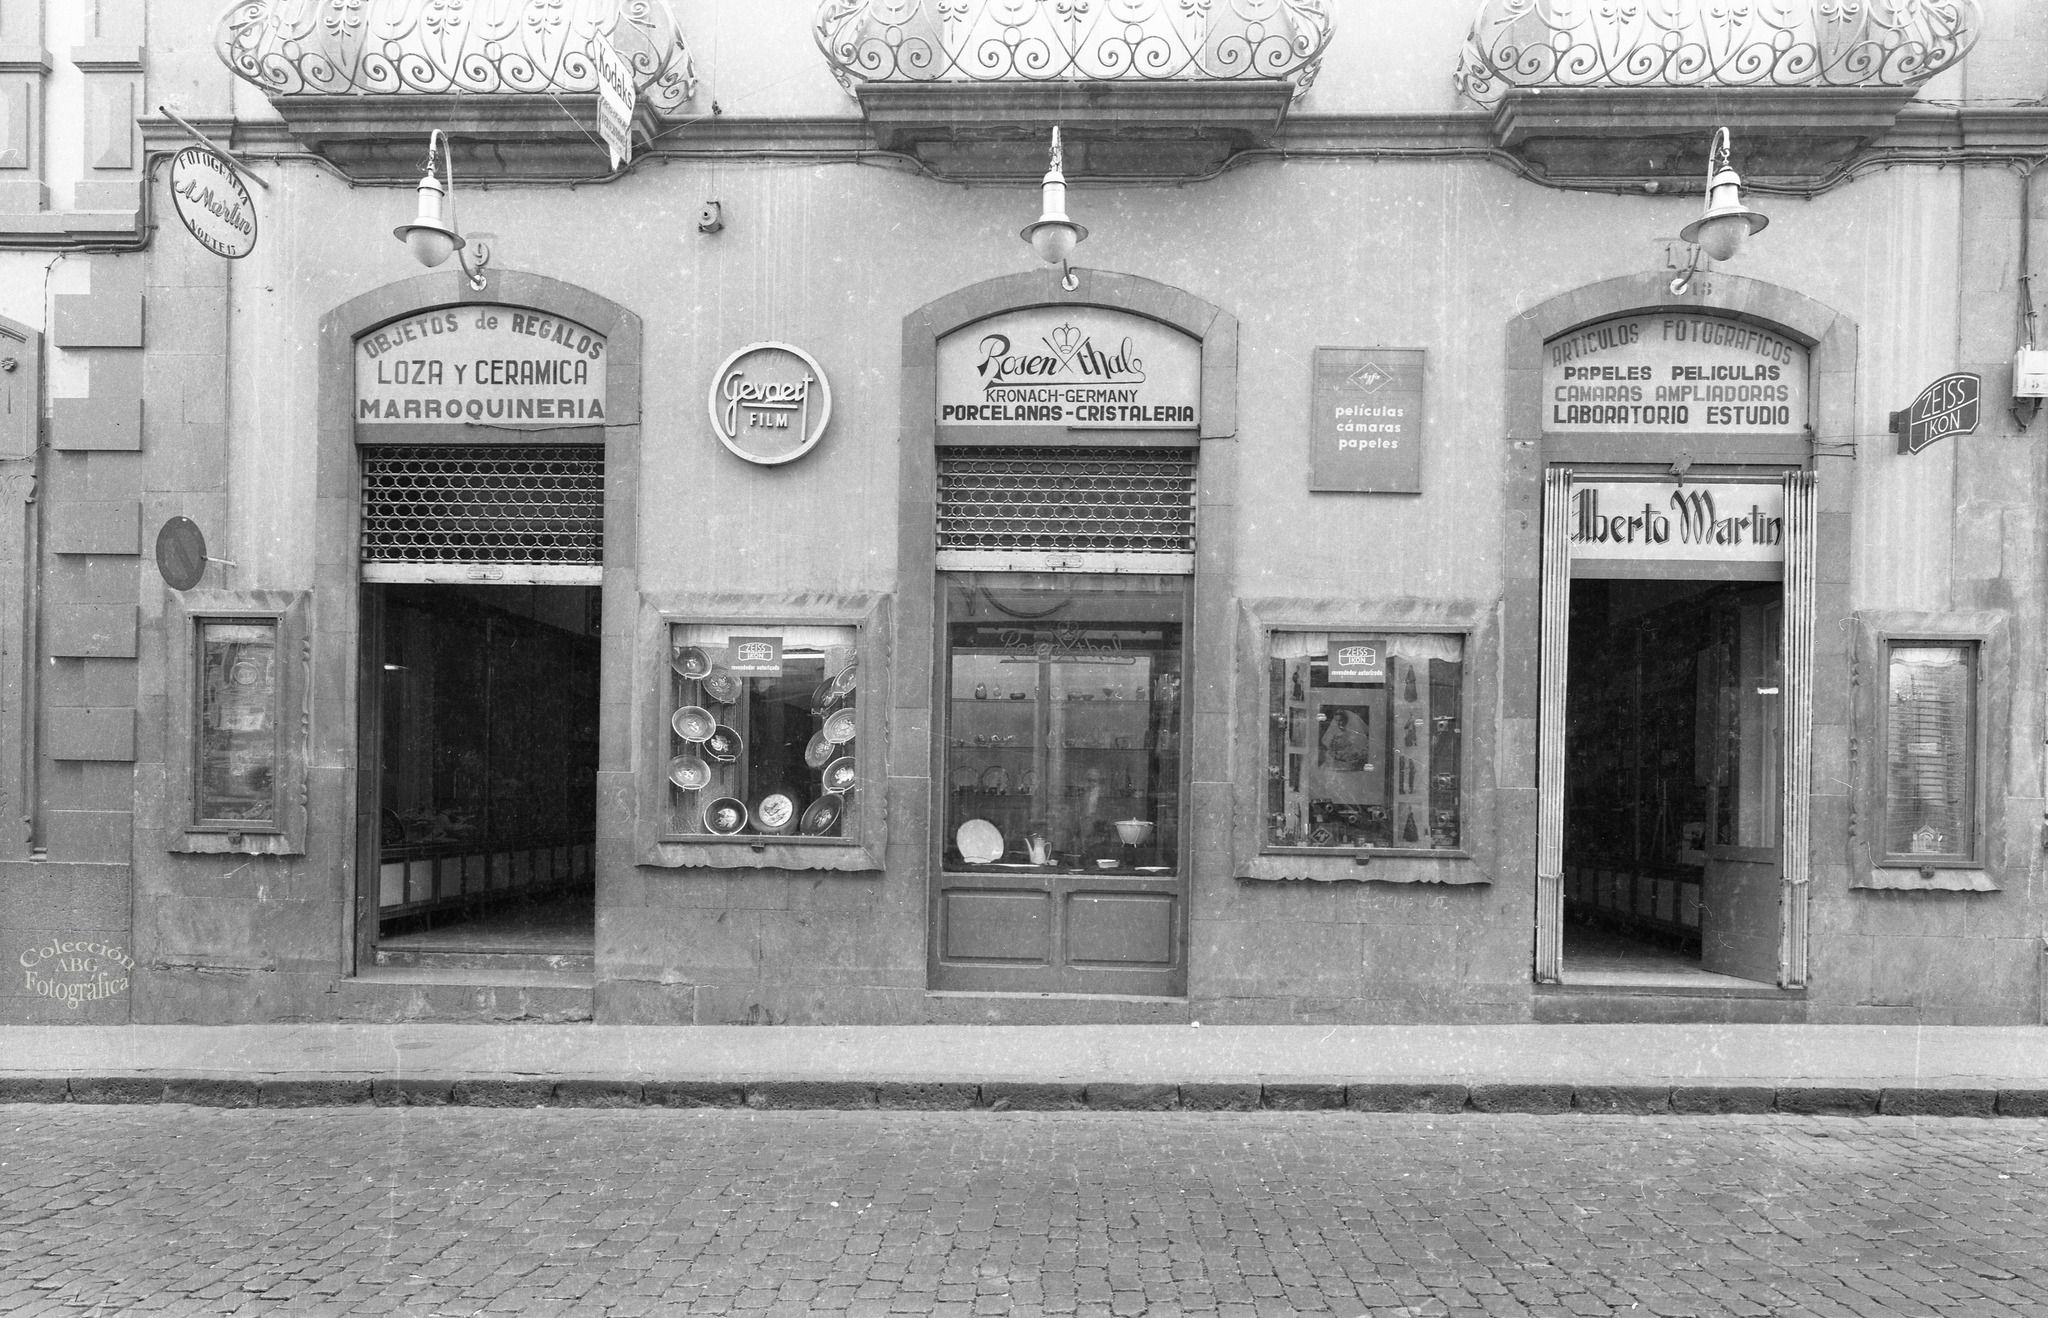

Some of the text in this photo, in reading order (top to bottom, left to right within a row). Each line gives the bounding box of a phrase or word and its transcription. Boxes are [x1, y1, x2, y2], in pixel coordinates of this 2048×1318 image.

[179, 151, 248, 206] FOTOGRAFIA
[191, 186, 252, 236] Martin
[190, 218, 225, 253] NORTE
[469, 241, 490, 267] 9
[363, 310, 604, 360] OBJETOS de REGALOS
[1553, 319, 1793, 368] ARTICULOS FOTOGRAFICOS
[378, 359, 588, 385] LOZA Y CERAMICA
[1564, 365, 1781, 381] PAPELES PELICULAS
[986, 389, 1138, 403] KRONACH-GERMANY
[1555, 384, 1789, 402] CAMARAS AMPLIADORAS
[1921, 379, 1965, 419] ZEISS
[359, 399, 605, 420] MARROQUINERIA
[723, 370, 814, 442] Gevaert
[1335, 403, 1404, 419] películas
[1553, 405, 1790, 425] LABORATORIO ESTUDIO
[749, 412, 789, 428] FILM
[1336, 419, 1401, 433] cámaras
[1924, 409, 1960, 441] IKON
[1338, 437, 1399, 451] papeles
[1570, 488, 1783, 545] Alberto Martin
[746, 643, 766, 653] ZEISS
[1347, 647, 1368, 657] ZEISS
[1348, 656, 1366, 664] IKON
